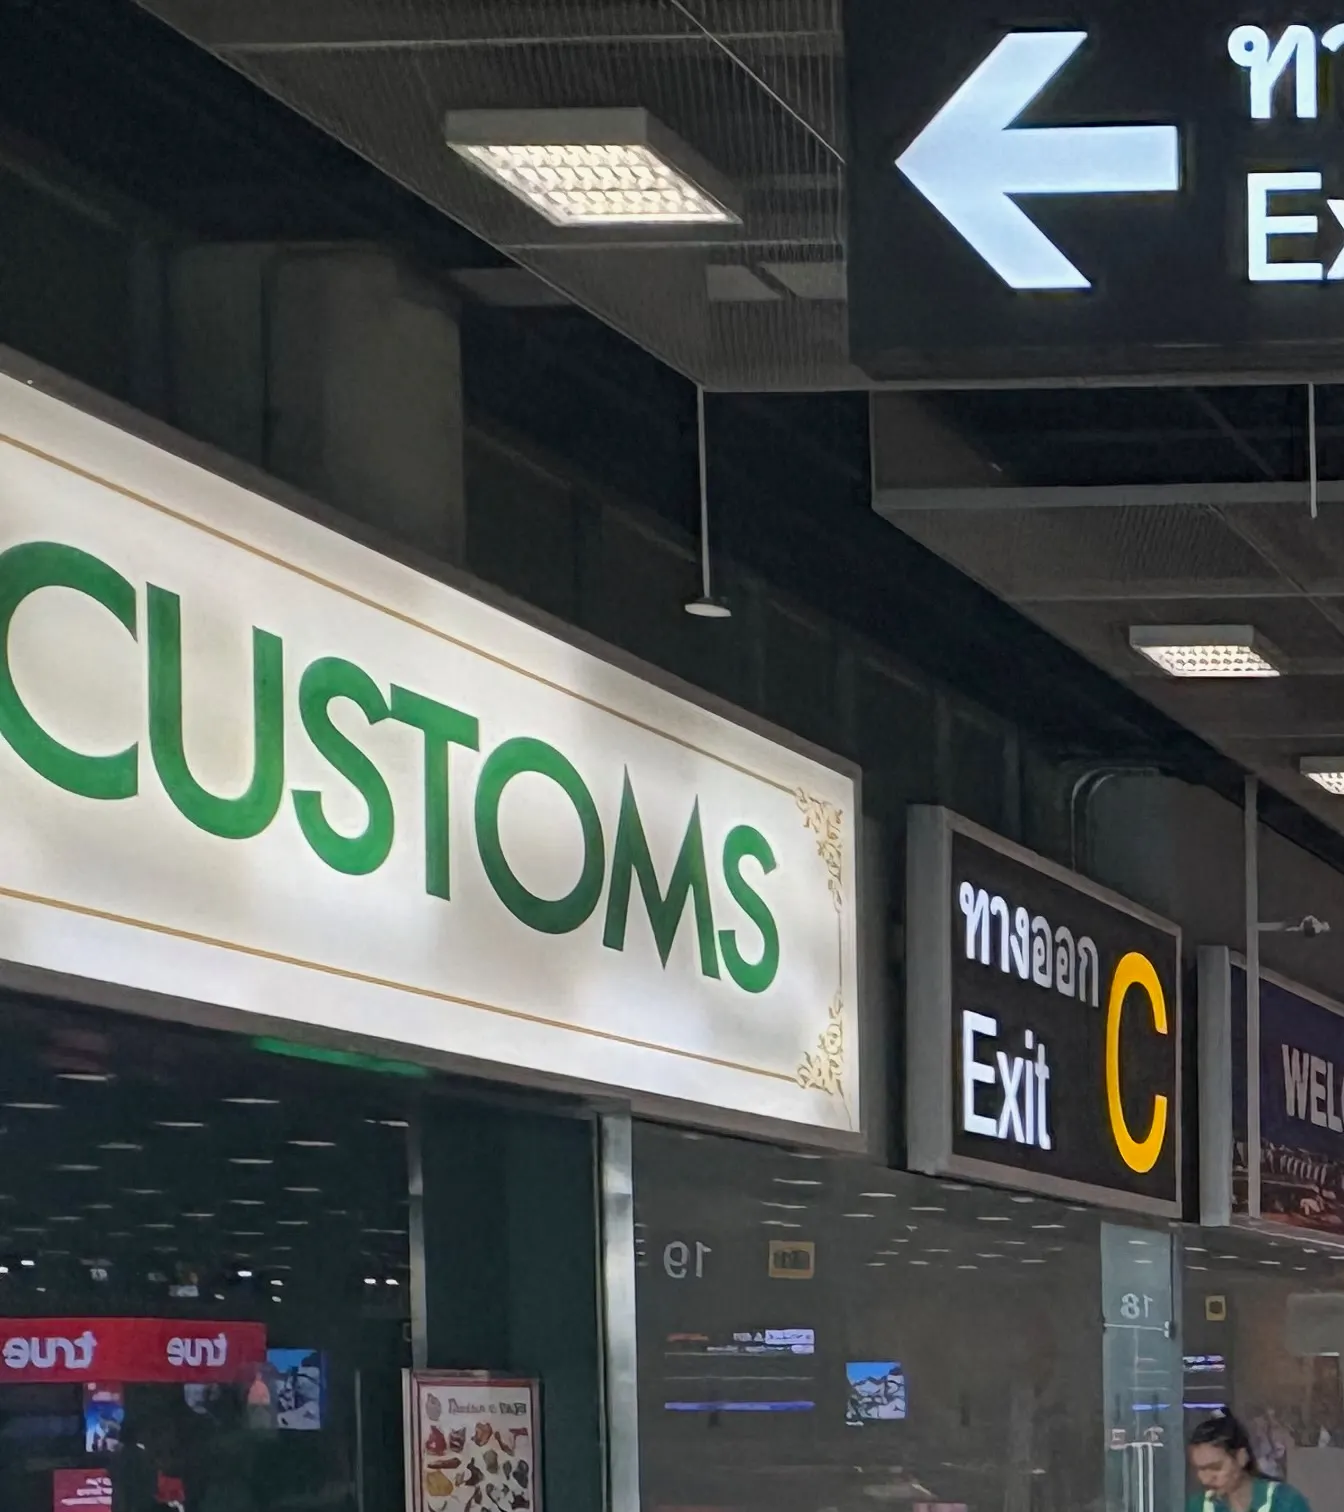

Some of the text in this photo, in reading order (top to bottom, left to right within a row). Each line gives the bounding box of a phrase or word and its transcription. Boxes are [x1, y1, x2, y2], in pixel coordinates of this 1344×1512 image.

[0, 540, 781, 994] CUSTOMS
[959, 881, 1099, 1008] ทางออก
[962, 1009, 1051, 1150] Exit
[1106, 951, 1168, 1173] C
